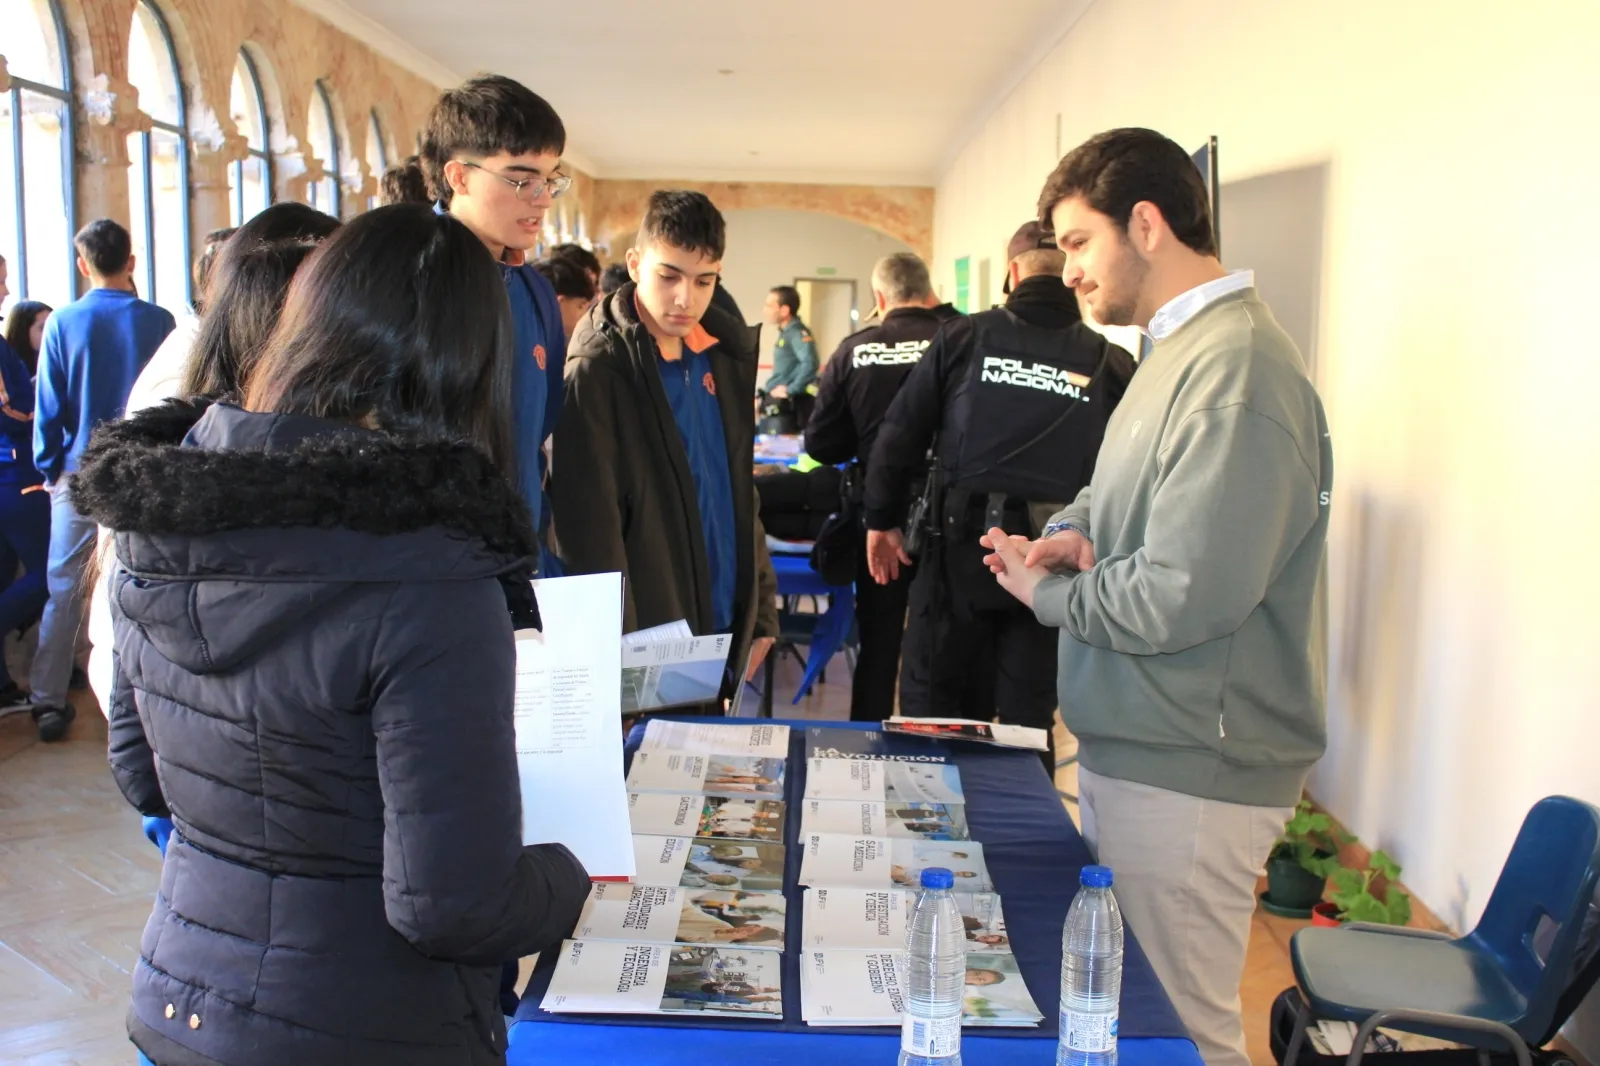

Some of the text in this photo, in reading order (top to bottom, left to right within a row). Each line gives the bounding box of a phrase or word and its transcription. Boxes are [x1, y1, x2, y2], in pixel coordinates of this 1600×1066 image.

[853, 340, 930, 355] POLICIA
[983, 356, 1071, 384] POLICIA
[852, 845, 865, 872] MEDICINA
[865, 840, 876, 861] SALUD
[865, 898, 877, 922] CIENCIA
[878, 892, 890, 936] INVESTIGACIÓN
[616, 952, 637, 993] TECNOLOGÍA
[632, 946, 652, 987] INGENIERÍA
[867, 959, 884, 994] GOBIERNO
